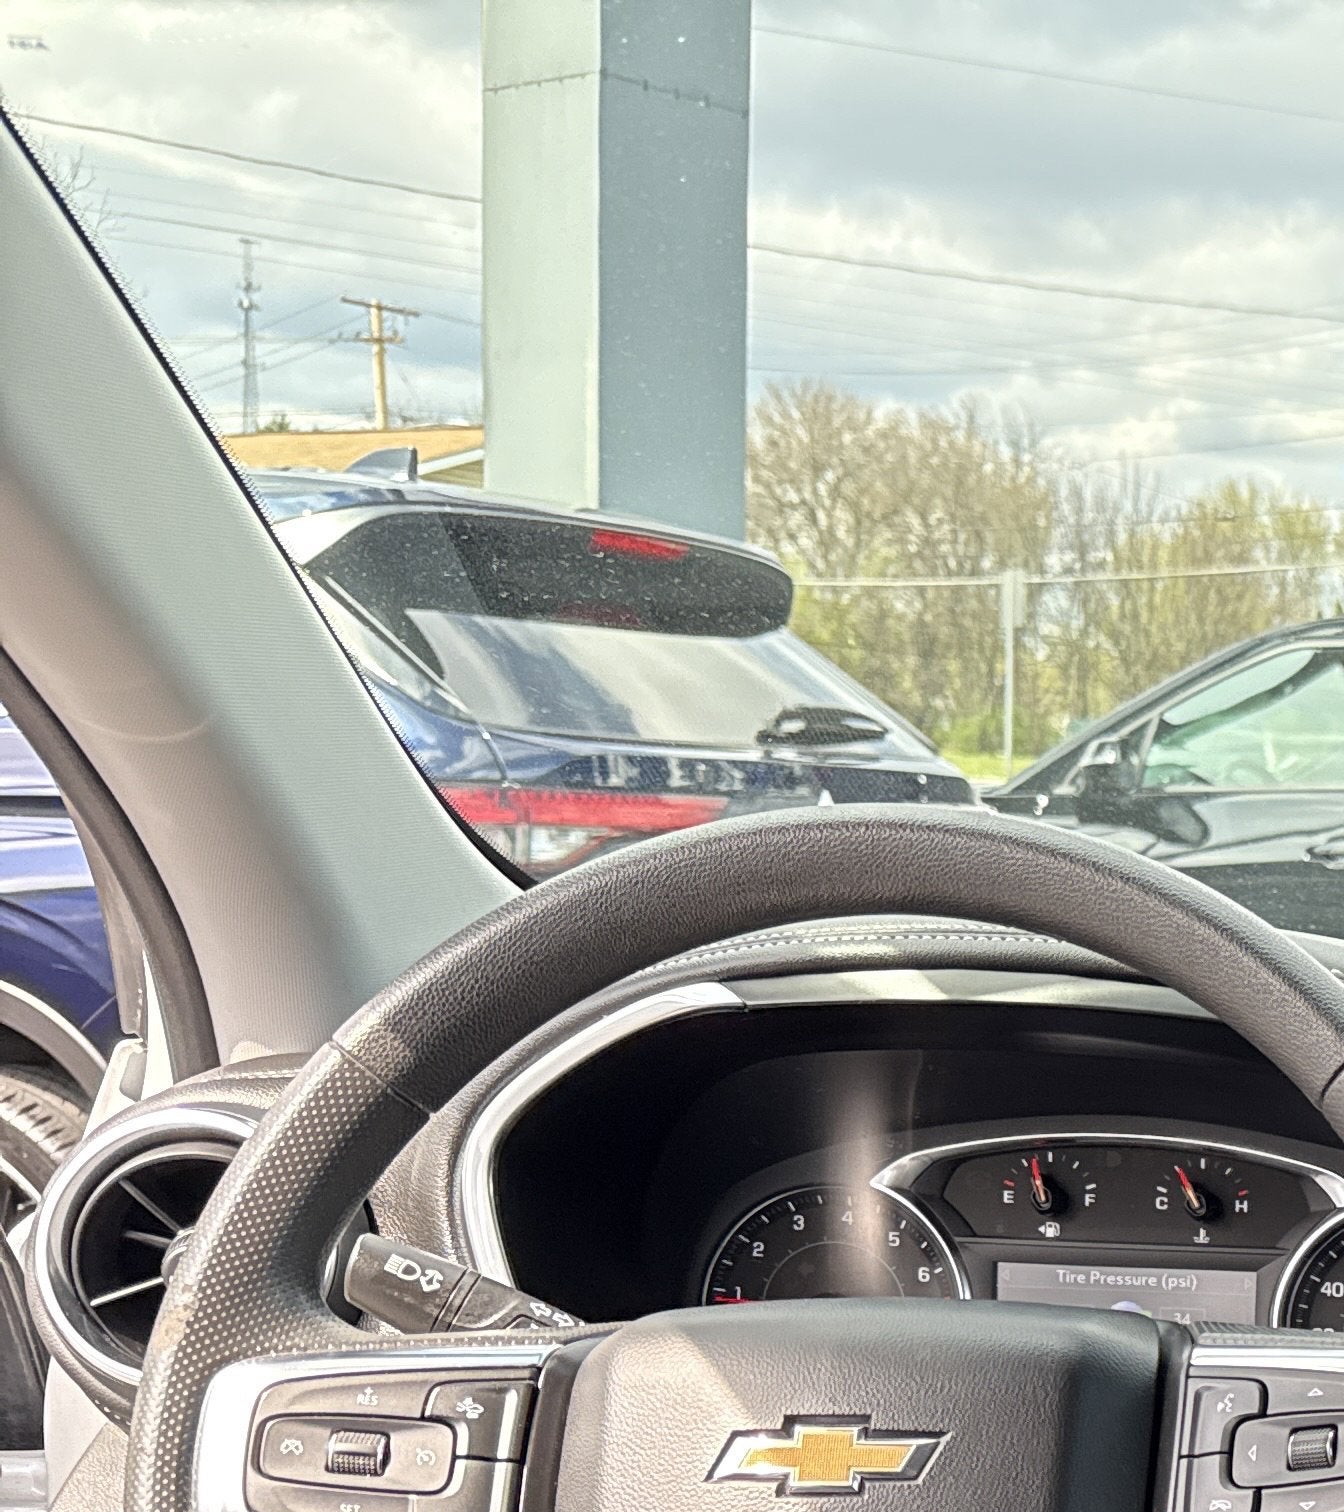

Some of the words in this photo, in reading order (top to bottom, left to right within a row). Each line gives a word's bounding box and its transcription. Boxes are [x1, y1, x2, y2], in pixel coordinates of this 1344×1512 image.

[1003, 1190, 1015, 1204] E
[1084, 1193, 1096, 1207] F
[1155, 1196, 1168, 1211] C
[1234, 1200, 1248, 1214] H
[793, 1215, 805, 1232] 3
[841, 1211, 853, 1226] 4
[888, 1232, 900, 1247] 5
[752, 1241, 765, 1258] 2
[917, 1266, 930, 1283] 6
[1056, 1269, 1086, 1285] Tire
[1090, 1270, 1158, 1288] Pressure
[1161, 1273, 1198, 1291] (psi)
[1320, 1281, 1344, 1298] 40
[356, 1393, 378, 1407] RES
